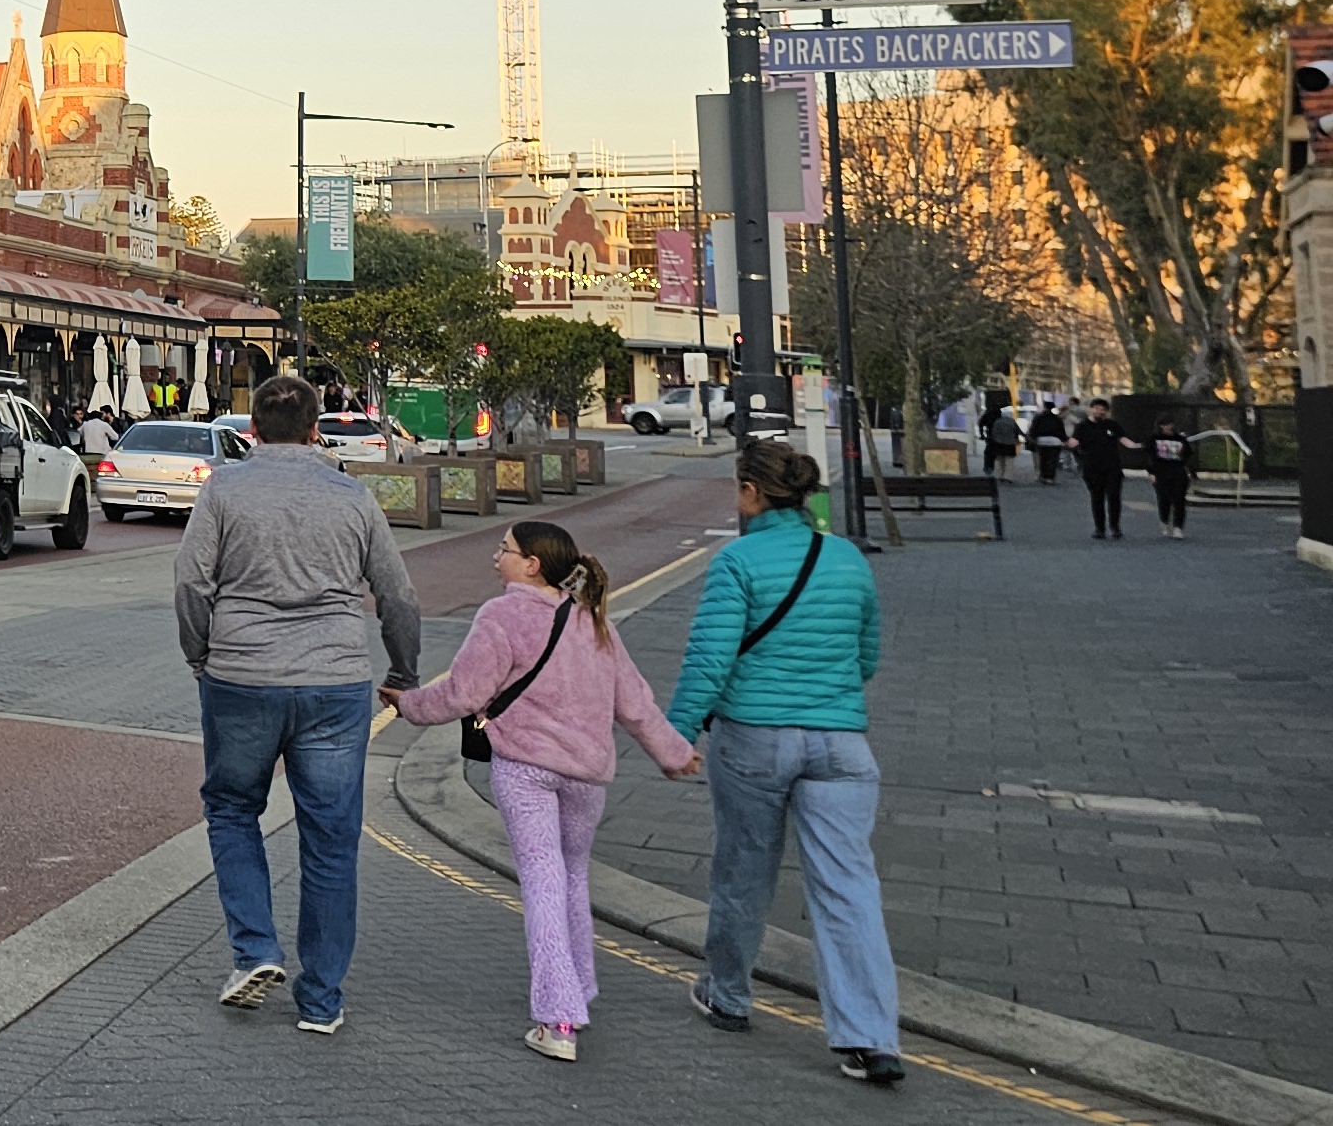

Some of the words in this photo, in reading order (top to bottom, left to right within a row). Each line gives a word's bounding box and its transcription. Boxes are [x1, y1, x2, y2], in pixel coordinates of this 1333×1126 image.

[774, 36, 865, 65] PIRATES
[876, 31, 1042, 62] BACKPACKERS
[312, 180, 331, 193] IS
[312, 195, 331, 224] THIS
[330, 180, 349, 250] FREMANTLE
